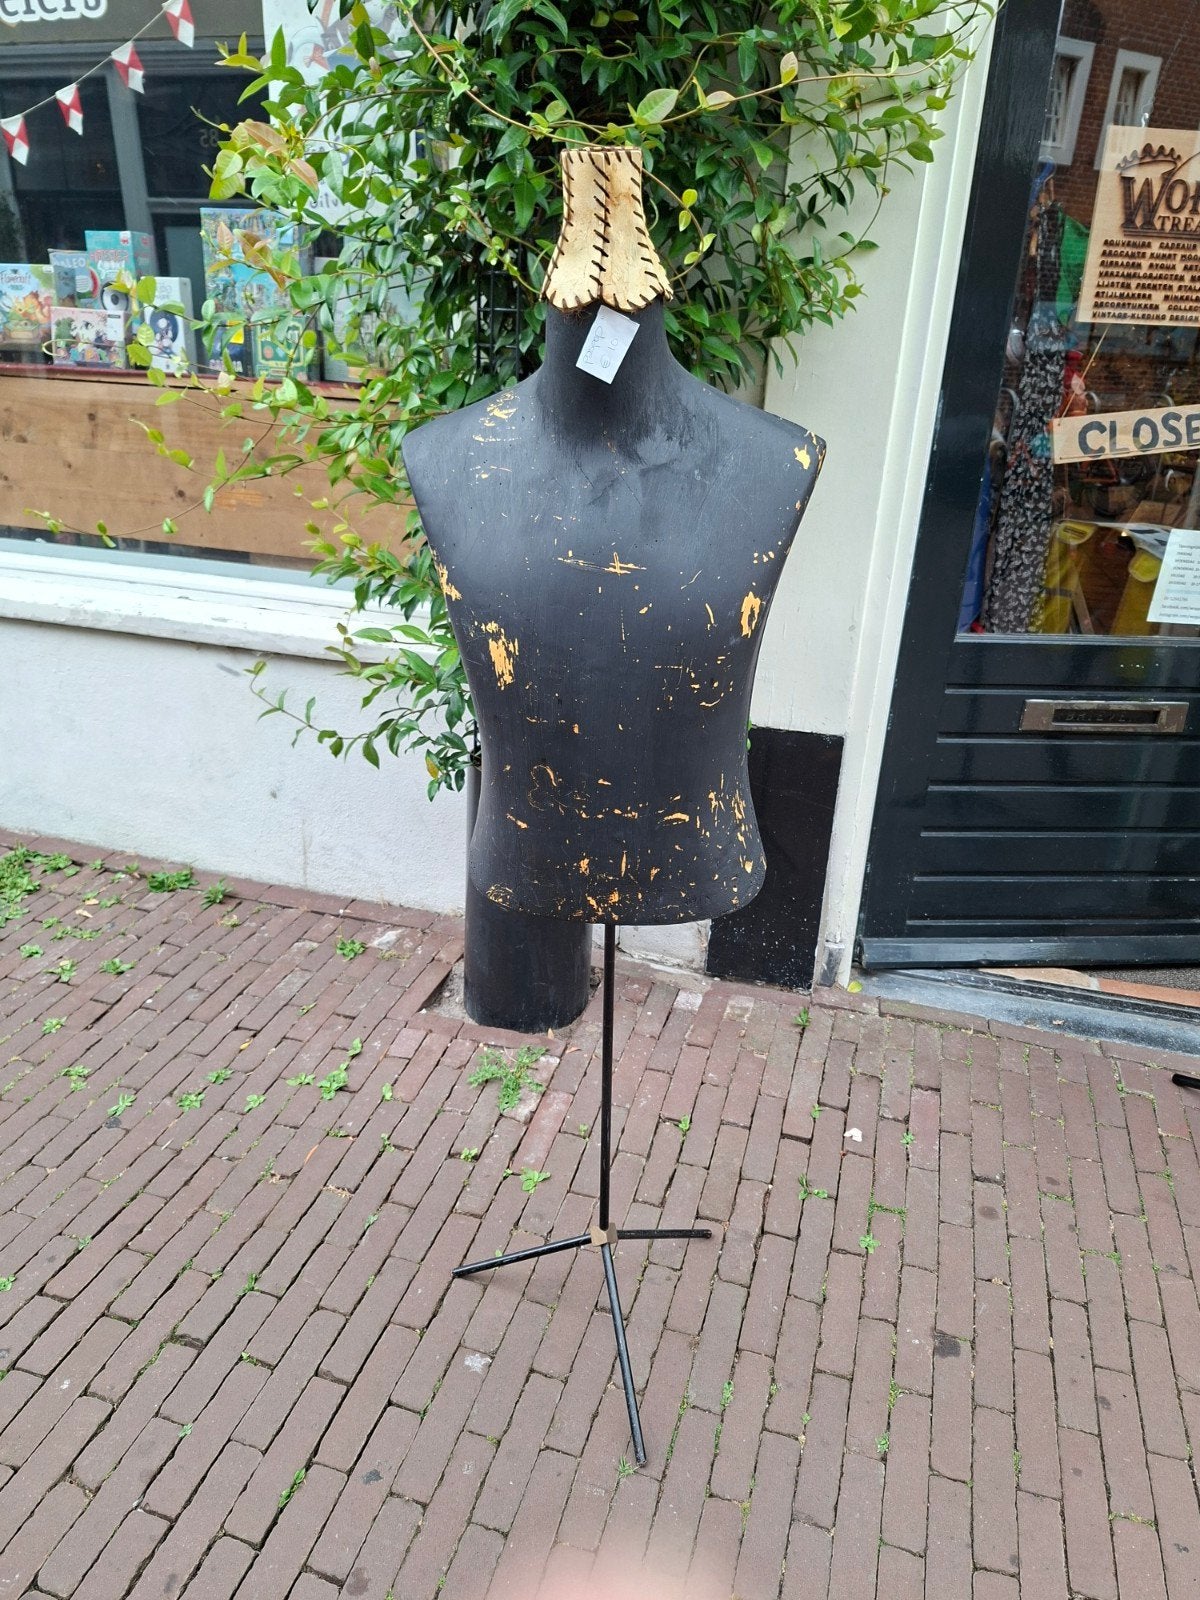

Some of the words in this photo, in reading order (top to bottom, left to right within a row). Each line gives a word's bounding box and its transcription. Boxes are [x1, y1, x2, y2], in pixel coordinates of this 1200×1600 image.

[1103, 239, 1152, 249] SOUVENIRS
[1101, 249, 1147, 259] BROCANTE
[1149, 251, 1177, 260] KUNST
[1180, 253, 1200, 262] WOO
[1099, 260, 1142, 270] SIERADEN
[1099, 271, 1185, 281] VERZAMELOBJECTEN
[1096, 281, 1132, 290] LIJSTEN
[1135, 282, 1174, 291] PRENTEN
[1178, 284, 1200, 292] ETAL
[1094, 291, 1152, 300] STIJLMAKERS
[1093, 301, 1160, 310] DECORSTUKKEN
[1092, 311, 1166, 320] VINTAGE-KLEDING
[1078, 412, 1200, 458] CLOSE
